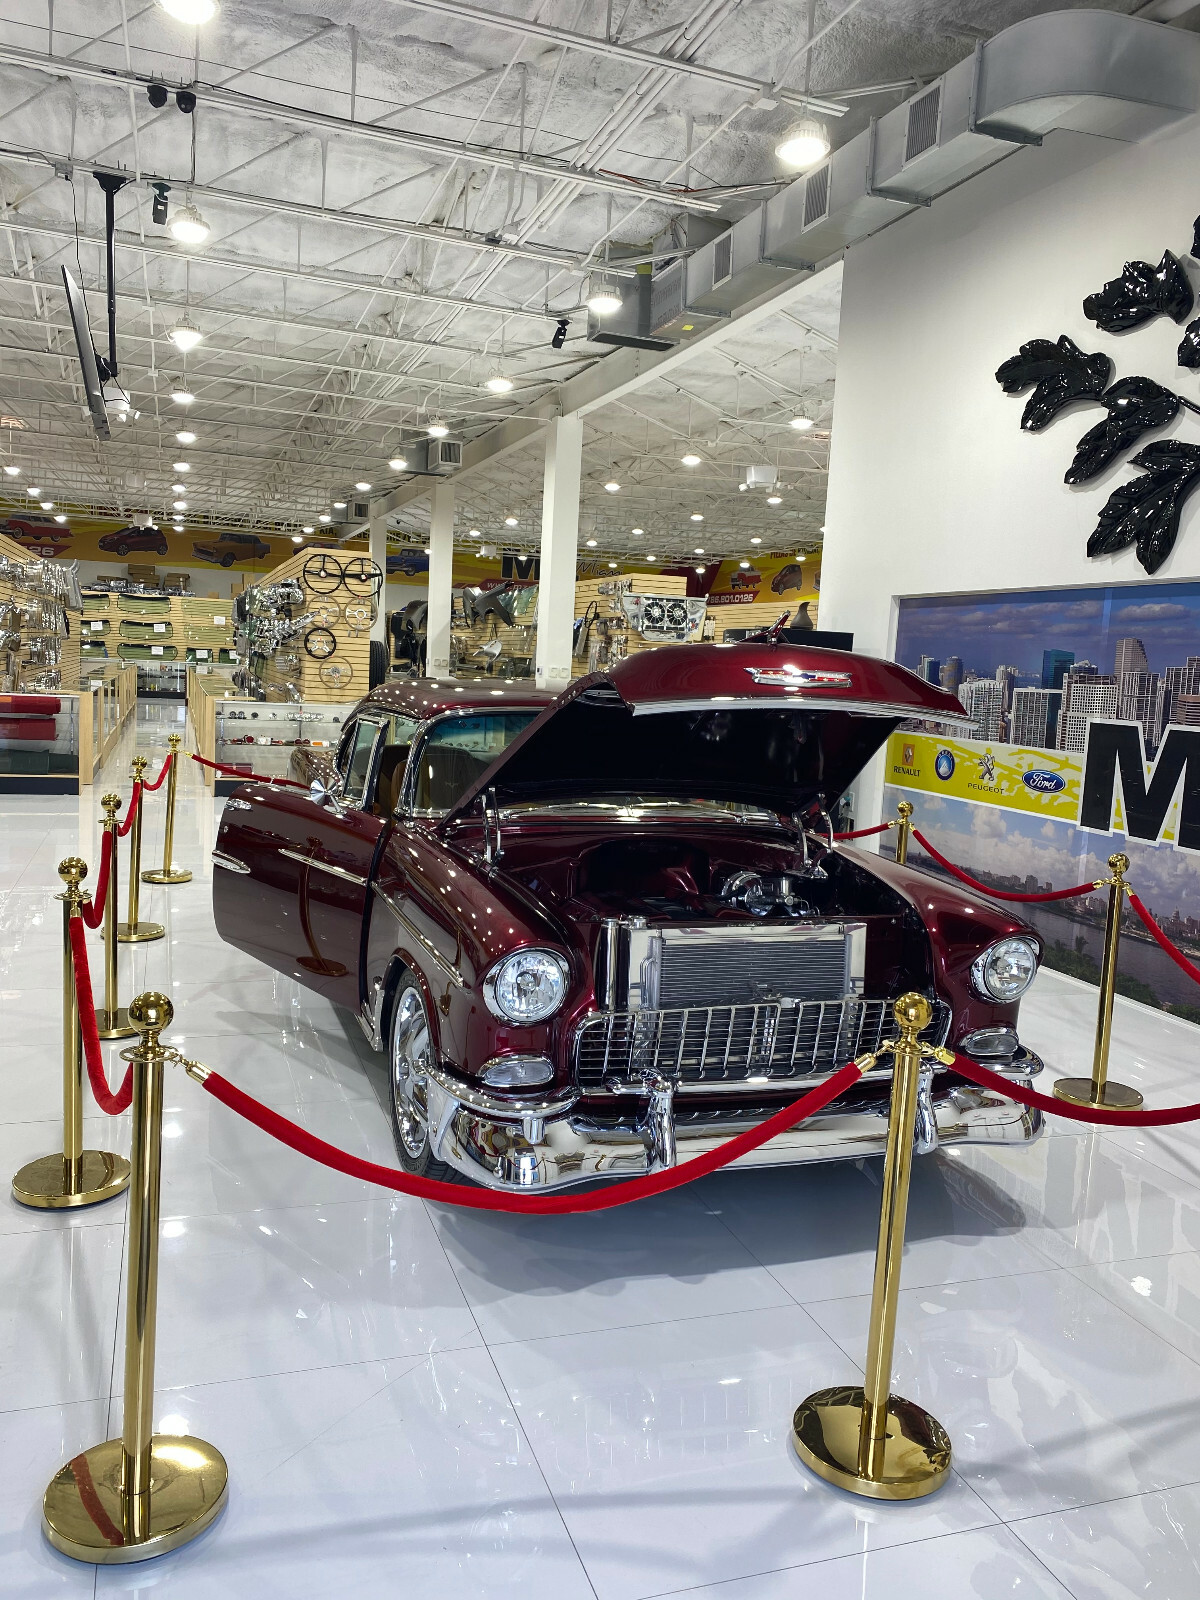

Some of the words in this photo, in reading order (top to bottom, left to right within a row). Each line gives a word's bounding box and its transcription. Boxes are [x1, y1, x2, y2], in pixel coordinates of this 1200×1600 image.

[894, 766, 921, 777] RENAULT
[967, 782, 1005, 794] PEUGEOT
[1032, 774, 1056, 790] Ford
